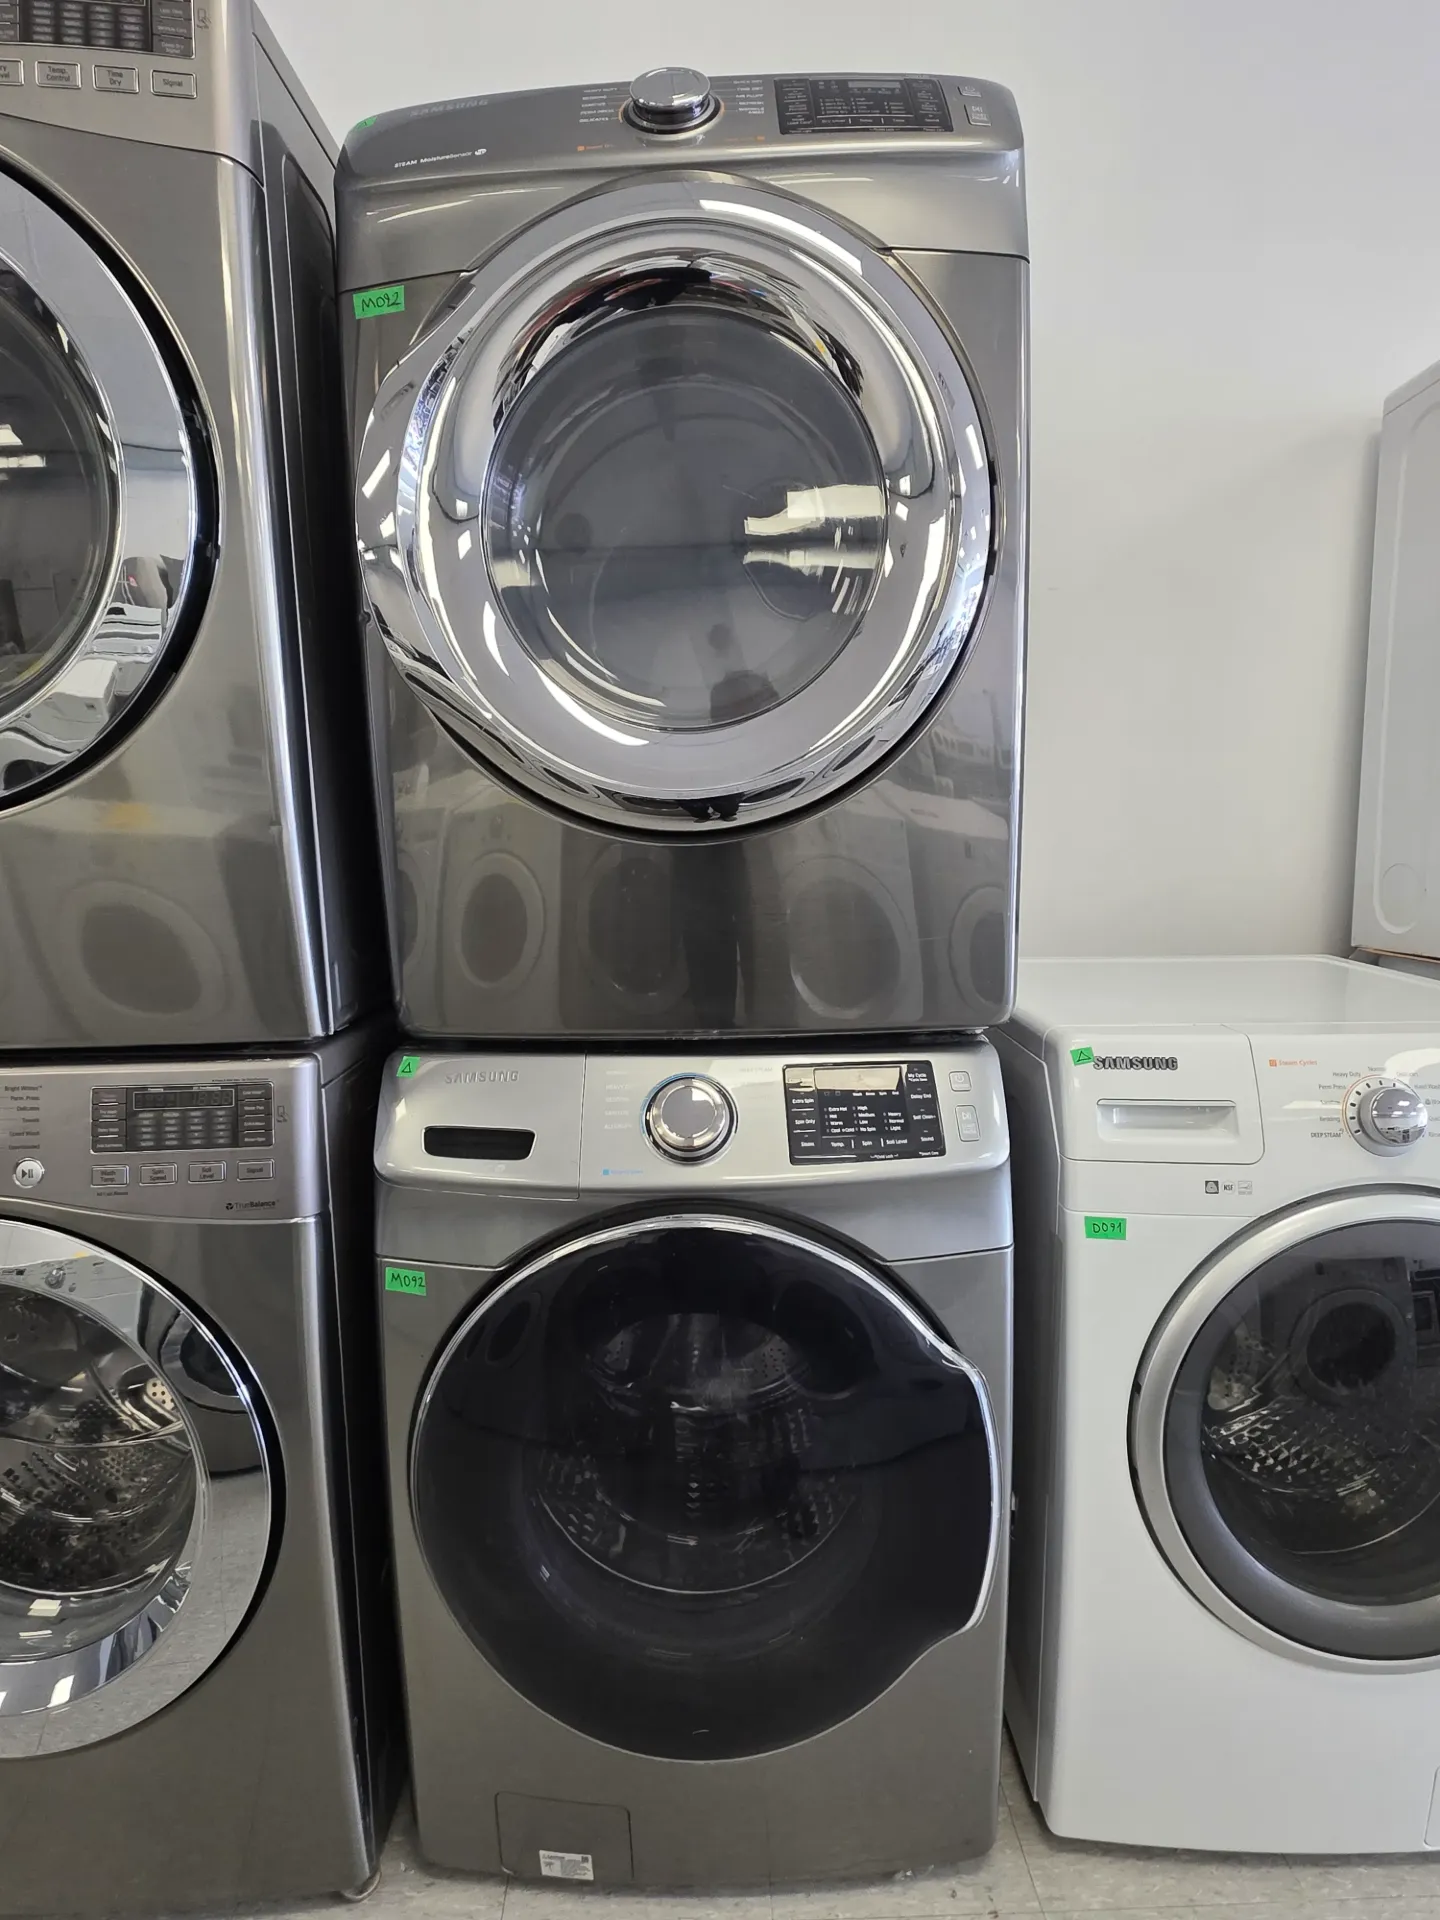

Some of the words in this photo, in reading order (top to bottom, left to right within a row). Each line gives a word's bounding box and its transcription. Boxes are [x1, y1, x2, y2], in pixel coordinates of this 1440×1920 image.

[46, 74, 71, 82] Control
[107, 69, 124, 79] Time
[109, 78, 122, 87] Dry
[162, 78, 184, 88] Signal
[394, 159, 418, 168] STEAM
[1093, 1056, 1179, 1071] SAMSUNG
[1299, 1059, 1318, 1067] Cycles
[444, 1069, 519, 1084] SAMSUNG
[100, 1169, 116, 1177] Wash
[152, 1168, 165, 1176] Spin
[246, 1166, 264, 1174] Signal
[150, 1174, 167, 1182] Speed
[1092, 1222, 1123, 1234] D091
[390, 1272, 426, 1289] M092
